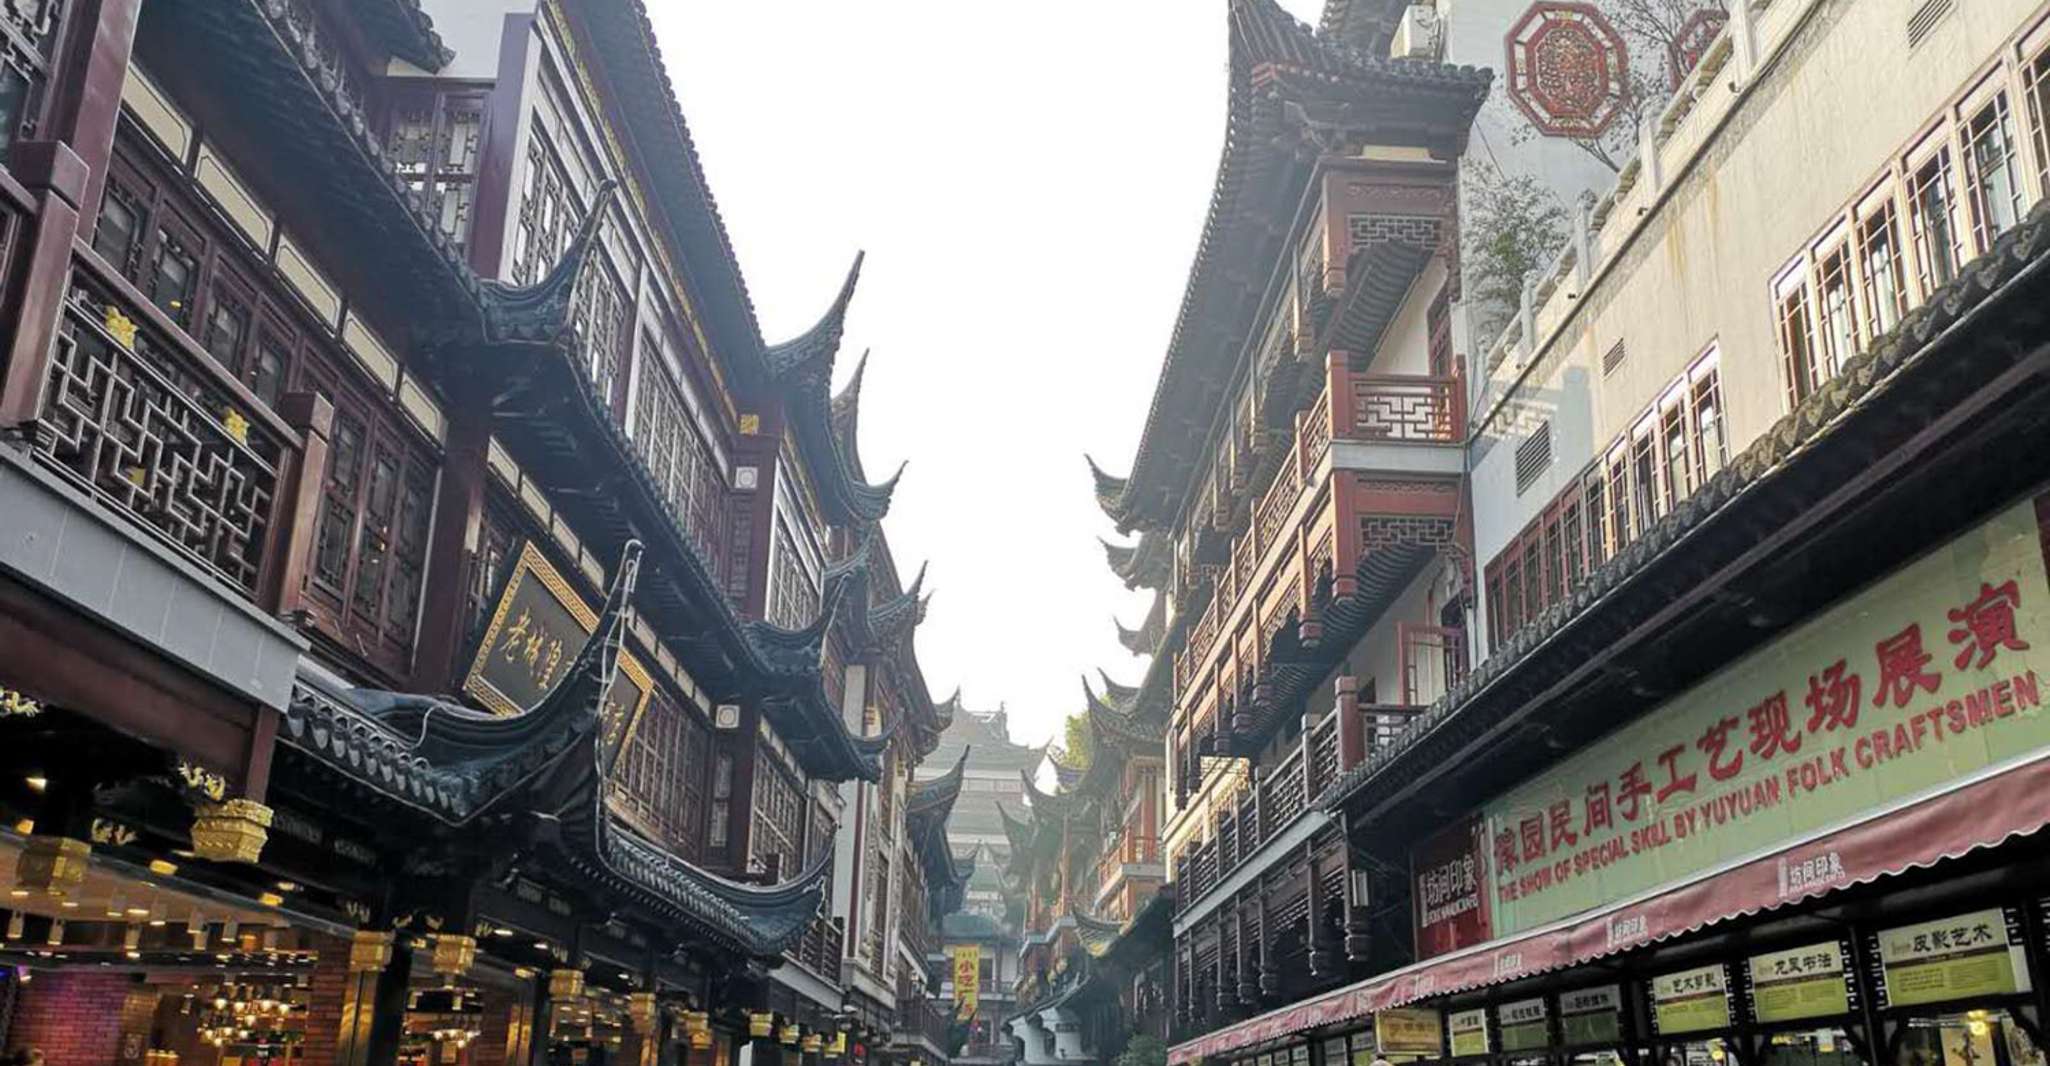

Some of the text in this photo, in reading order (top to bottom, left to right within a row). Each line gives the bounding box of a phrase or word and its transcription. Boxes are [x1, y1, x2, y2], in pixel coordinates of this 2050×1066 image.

[1495, 579, 2030, 876] 豫园民间手工艺现场展演
[1519, 865, 1551, 897] SHOW
[1555, 858, 1571, 883] OF
[1574, 835, 1629, 876] SPECIAL
[1674, 807, 1696, 839] BY
[1701, 775, 1781, 829] YUYUAN
[1787, 747, 1849, 798] FOLK
[1854, 670, 2040, 769] CRAFTSMEN
[1913, 923, 1993, 953] 皮影艺术
